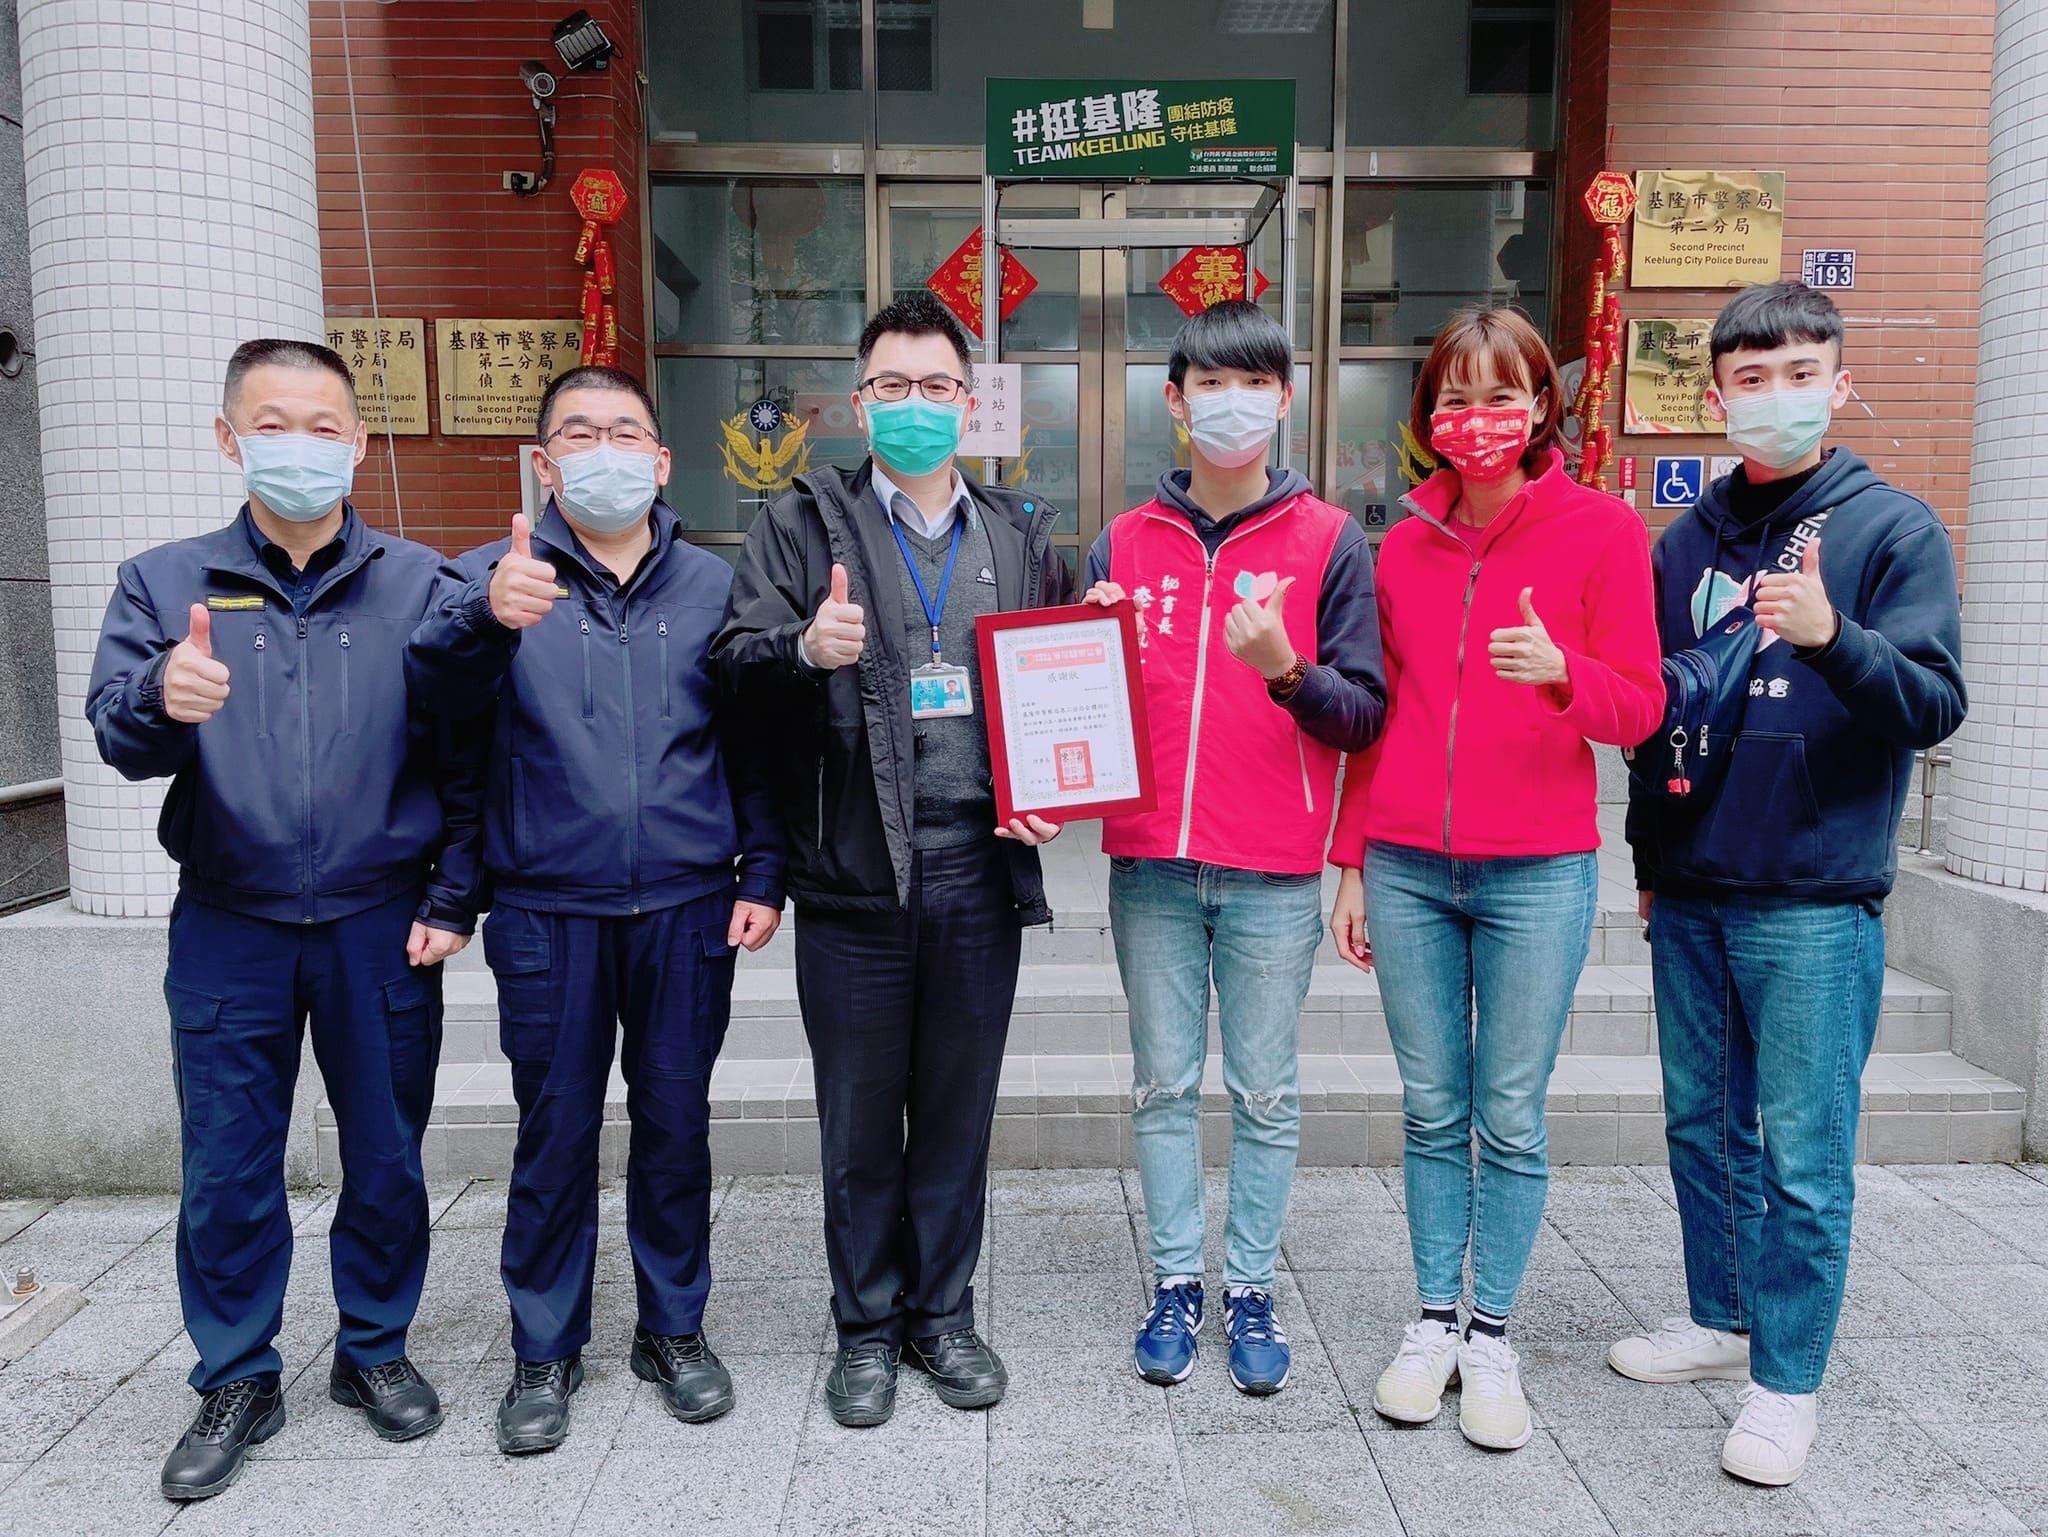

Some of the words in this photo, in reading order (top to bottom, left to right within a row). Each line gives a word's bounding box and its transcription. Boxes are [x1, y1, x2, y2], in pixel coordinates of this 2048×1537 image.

[1011, 88, 1163, 143] #挺基隆
[1167, 96, 1234, 124] 團結防疫
[1170, 117, 1238, 143] 守住基隆
[1648, 190, 1772, 210] 基隆市警察局
[1670, 216, 1750, 235] 第二分局
[1670, 243, 1704, 251] Second
[1707, 243, 1745, 251] Precinct
[1645, 256, 1682, 266] Keelung
[1685, 256, 1703, 266] City
[1705, 256, 1733, 264] Police
[1735, 256, 1769, 264] Bureau
[1816, 265, 1851, 285] 193
[449, 330, 580, 351] 基隆市警察局
[1641, 330, 1711, 350] 基隆市
[478, 353, 553, 370] 第二分局
[445, 394, 484, 402] Criminal
[486, 394, 544, 403] Investigatio
[1656, 393, 1679, 402] Xinyi
[1681, 393, 1703, 401] Polic
[477, 405, 512, 414] Second
[1661, 404, 1695, 412] Second
[453, 416, 493, 425] Keelung
[495, 416, 513, 425] City
[1639, 415, 1675, 423] Keelung
[1677, 415, 1695, 423] City
[1777, 506, 1833, 571] CHEN
[1158, 575, 1180, 635] 秘書長
